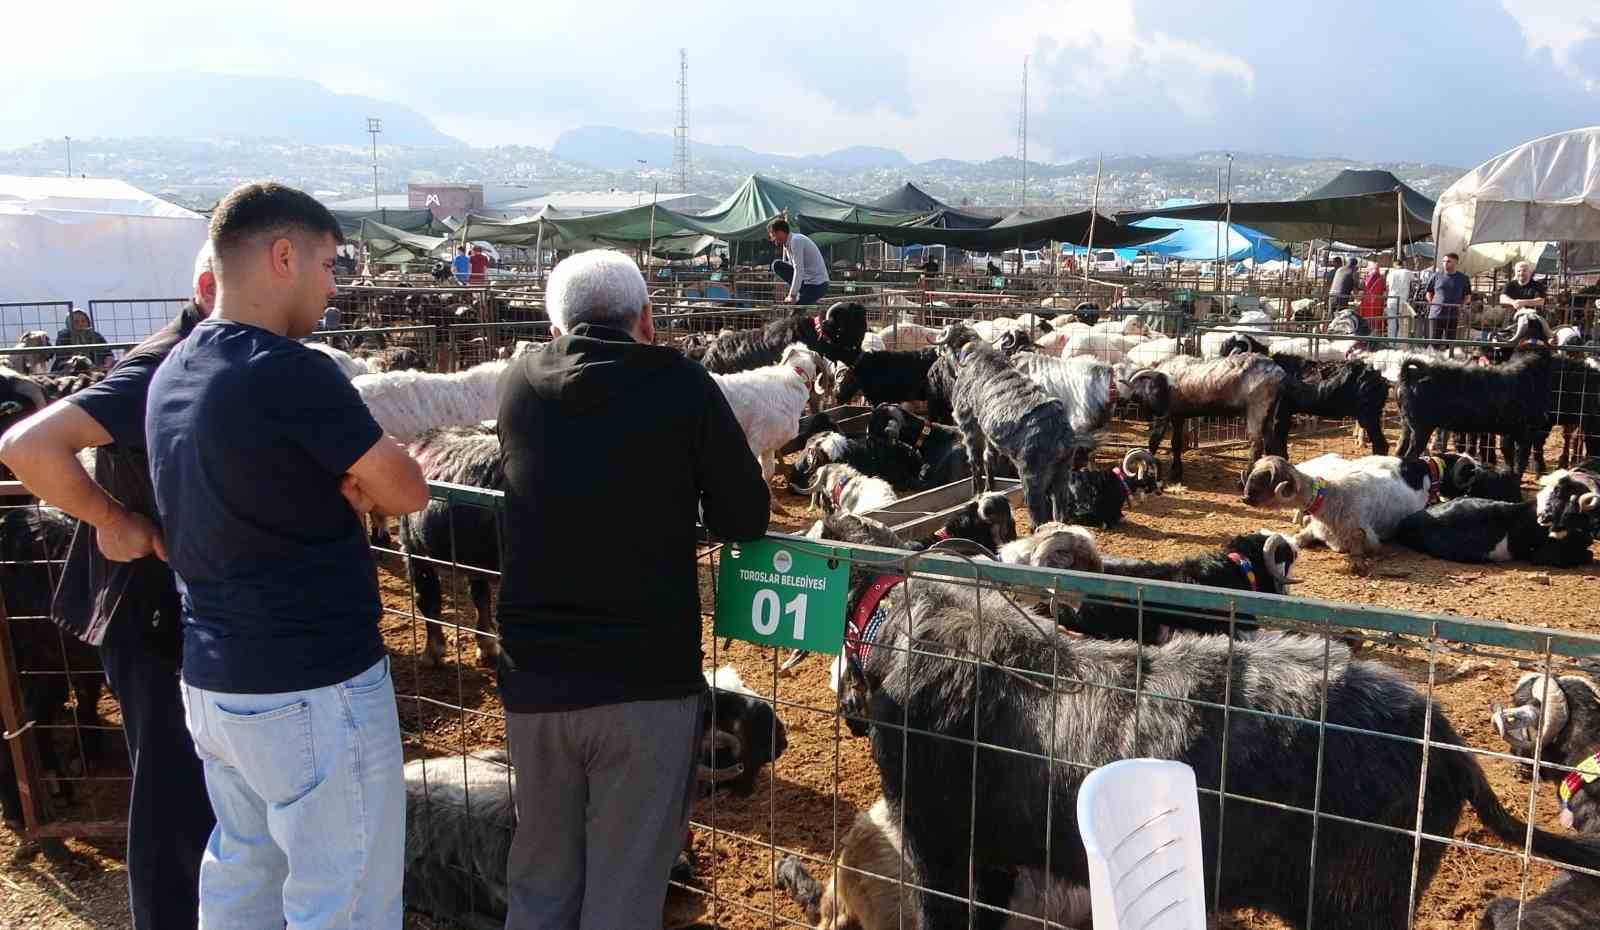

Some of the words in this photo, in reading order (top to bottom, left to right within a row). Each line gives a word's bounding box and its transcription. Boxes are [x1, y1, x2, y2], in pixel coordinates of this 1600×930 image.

[739, 569, 780, 585] TOROSLAR
[781, 575, 827, 591] BELEDİYESİ
[751, 588, 808, 641] 01
